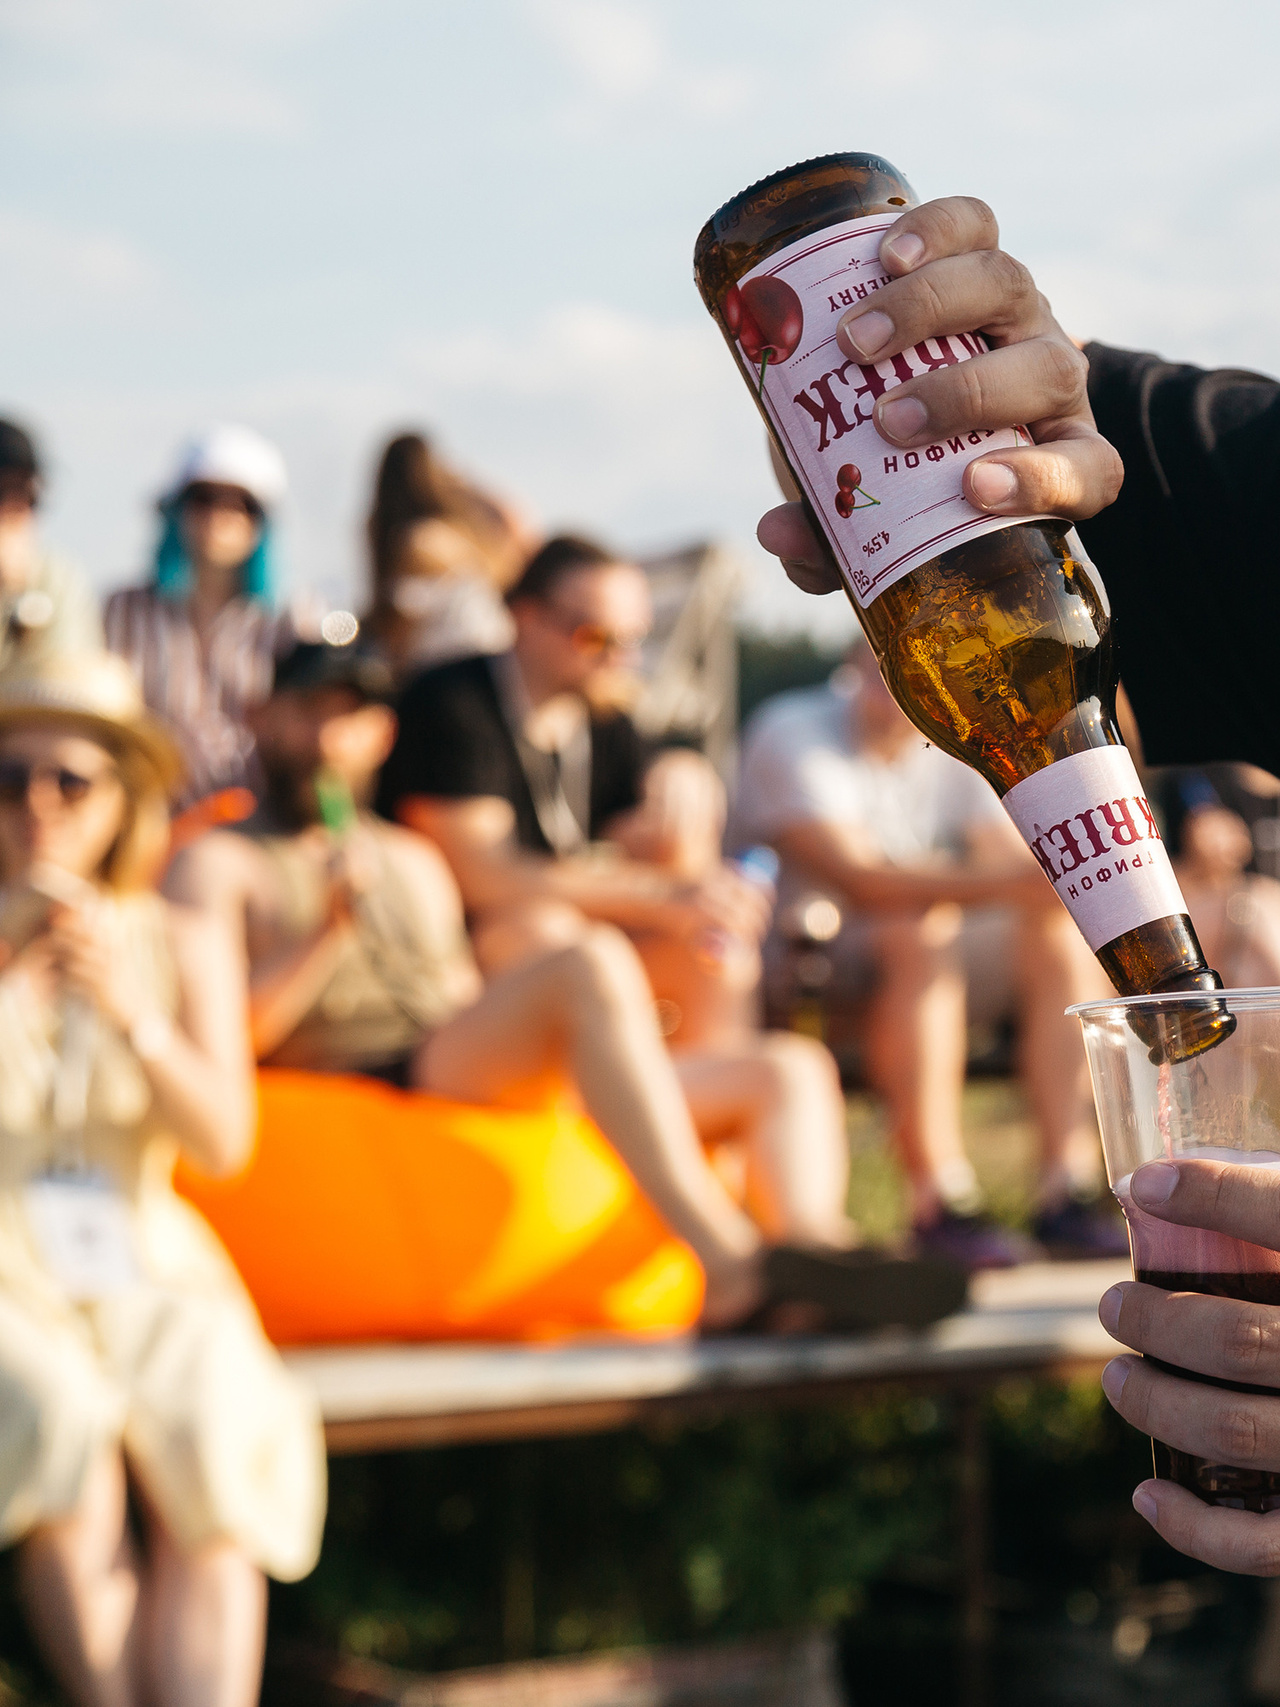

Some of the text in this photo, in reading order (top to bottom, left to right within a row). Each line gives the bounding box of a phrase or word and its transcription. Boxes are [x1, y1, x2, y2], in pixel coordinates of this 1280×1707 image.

[827, 275, 894, 313] HERRY
[862, 530, 891, 558] 4,5%
[1030, 796, 1163, 883] KRIEK
